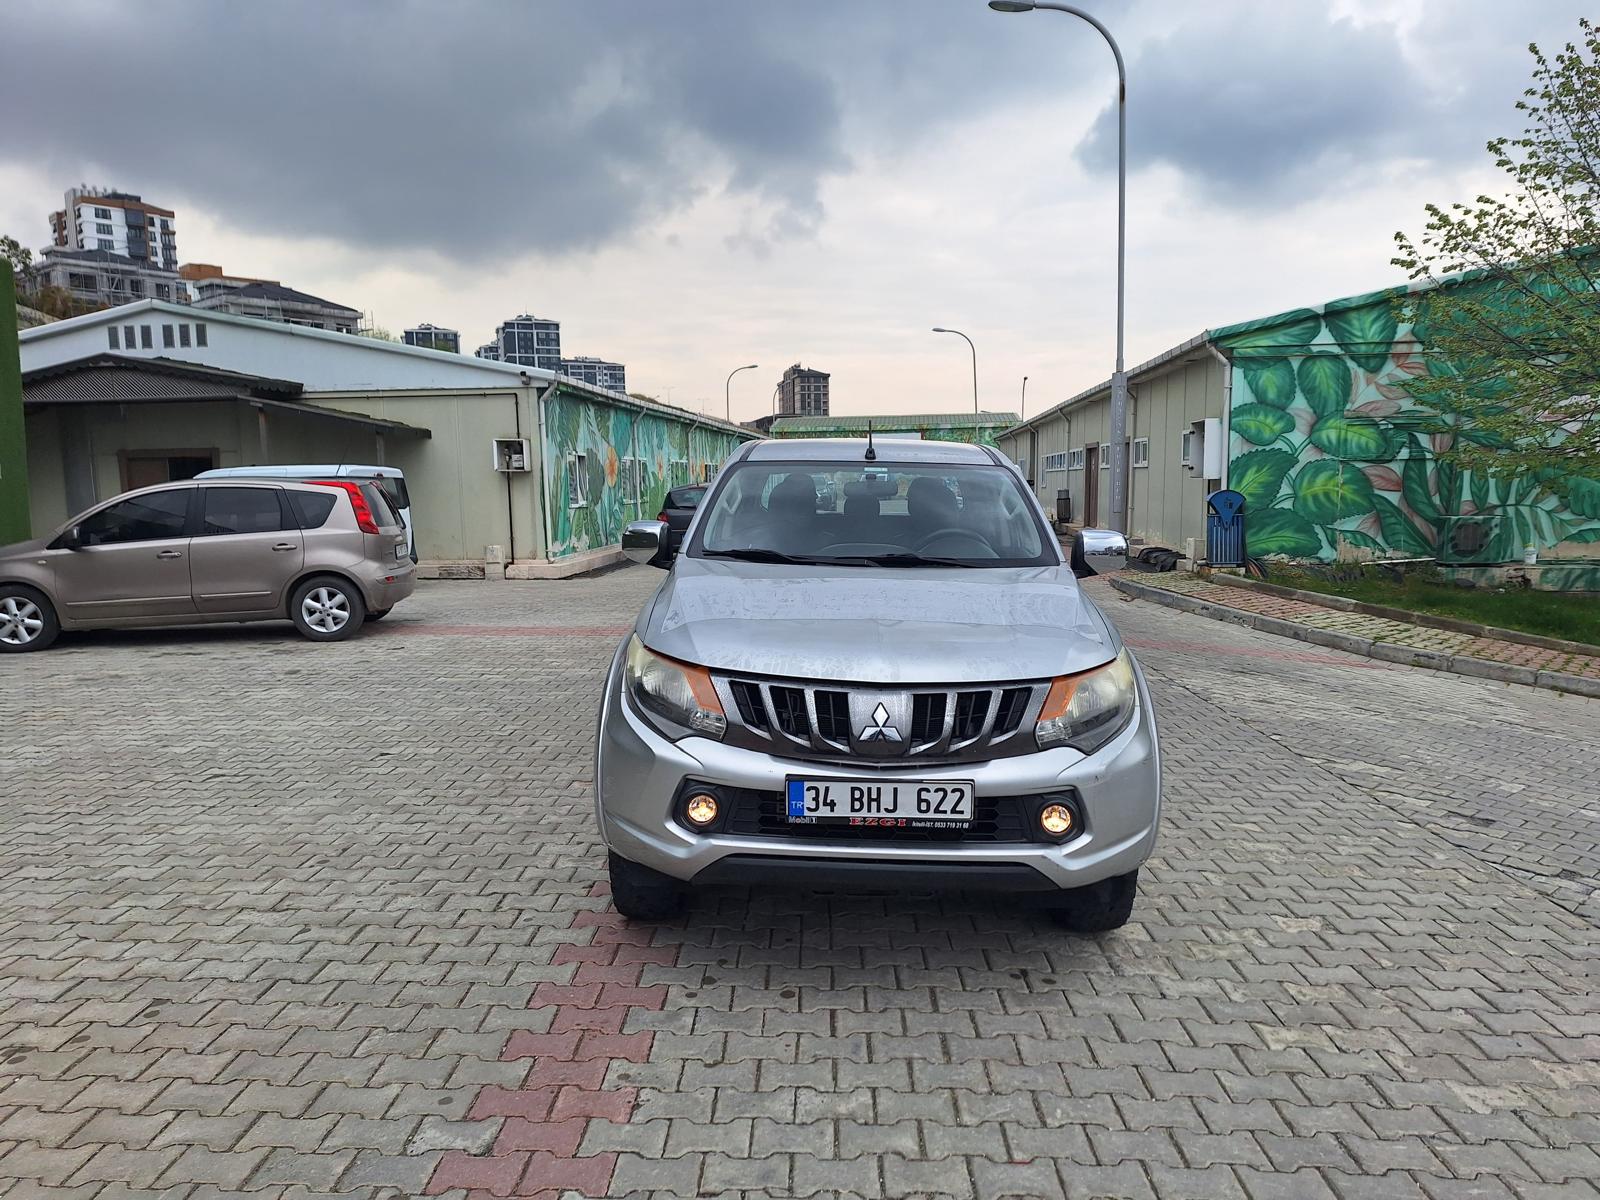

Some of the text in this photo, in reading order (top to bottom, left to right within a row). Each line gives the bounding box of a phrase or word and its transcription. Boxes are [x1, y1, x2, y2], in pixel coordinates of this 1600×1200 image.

[791, 786, 965, 815] TR 34 BHJ 622
